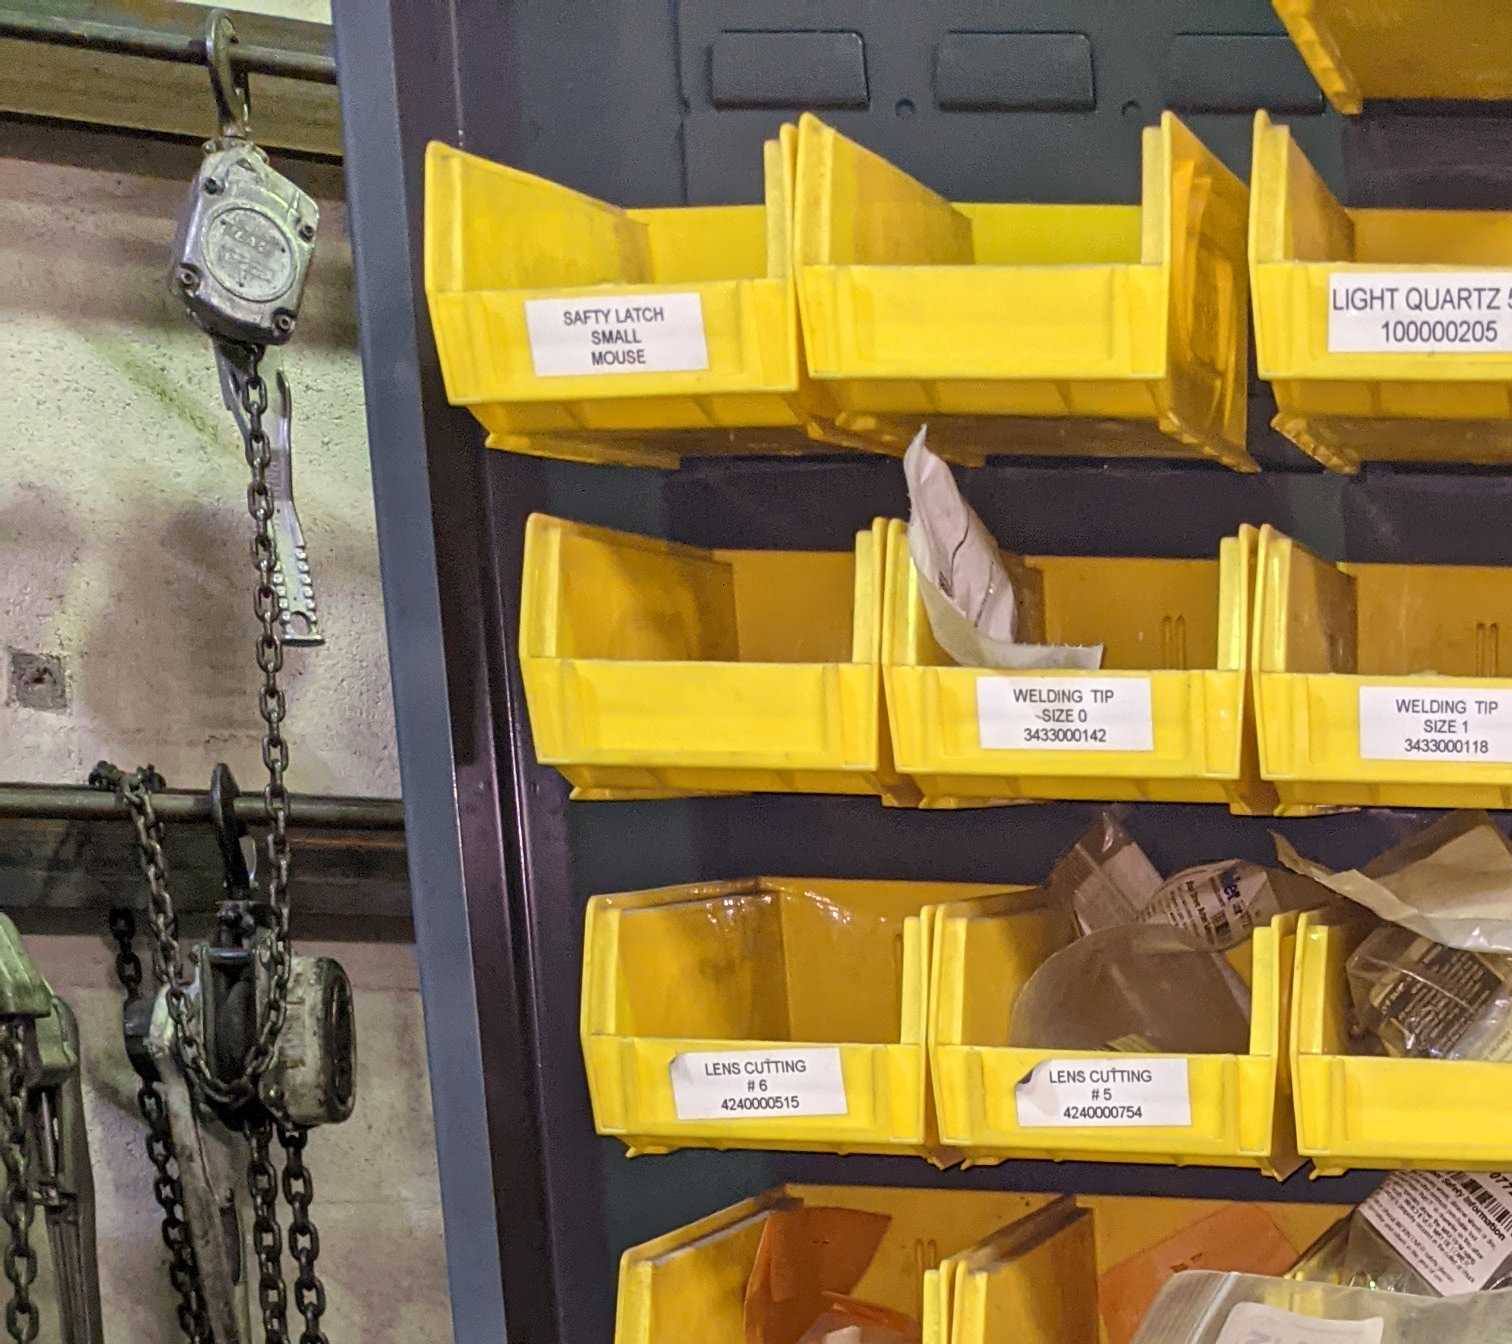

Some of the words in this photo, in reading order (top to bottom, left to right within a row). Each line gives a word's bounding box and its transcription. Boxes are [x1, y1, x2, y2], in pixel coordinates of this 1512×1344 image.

[1332, 288, 1399, 311] LIGHT
[1406, 288, 1501, 312] QUARTZ
[564, 309, 610, 326] SAFTY
[615, 306, 664, 323] LATCH
[591, 329, 642, 345] SMALL
[1381, 320, 1498, 343] 100000205
[591, 349, 646, 366] MOUSE
[1013, 688, 1083, 703] WELDING
[1090, 690, 1114, 703] TIP
[1395, 699, 1467, 714] WELDING
[1475, 701, 1498, 715] TIP
[1042, 709, 1074, 723] SIZE
[1078, 709, 1088, 723] 0
[1423, 719, 1457, 733] SIZE
[1461, 721, 1468, 733] 1
[1024, 728, 1107, 743] 3433000142
[1404, 738, 1489, 754] 3433000118
[705, 1062, 741, 1076] LENS
[744, 1059, 807, 1074] CUTTING
[1049, 1070, 1086, 1084] LENS
[1089, 1069, 1153, 1083] CUTTING
[747, 1080, 755, 1092] #
[759, 1079, 768, 1092] 6
[1091, 1089, 1100, 1101] #
[1103, 1088, 1112, 1101] 5
[721, 1096, 800, 1111] 4240000515
[1063, 1105, 1143, 1119] 4240000754
[1464, 1196, 1506, 1241] Information
